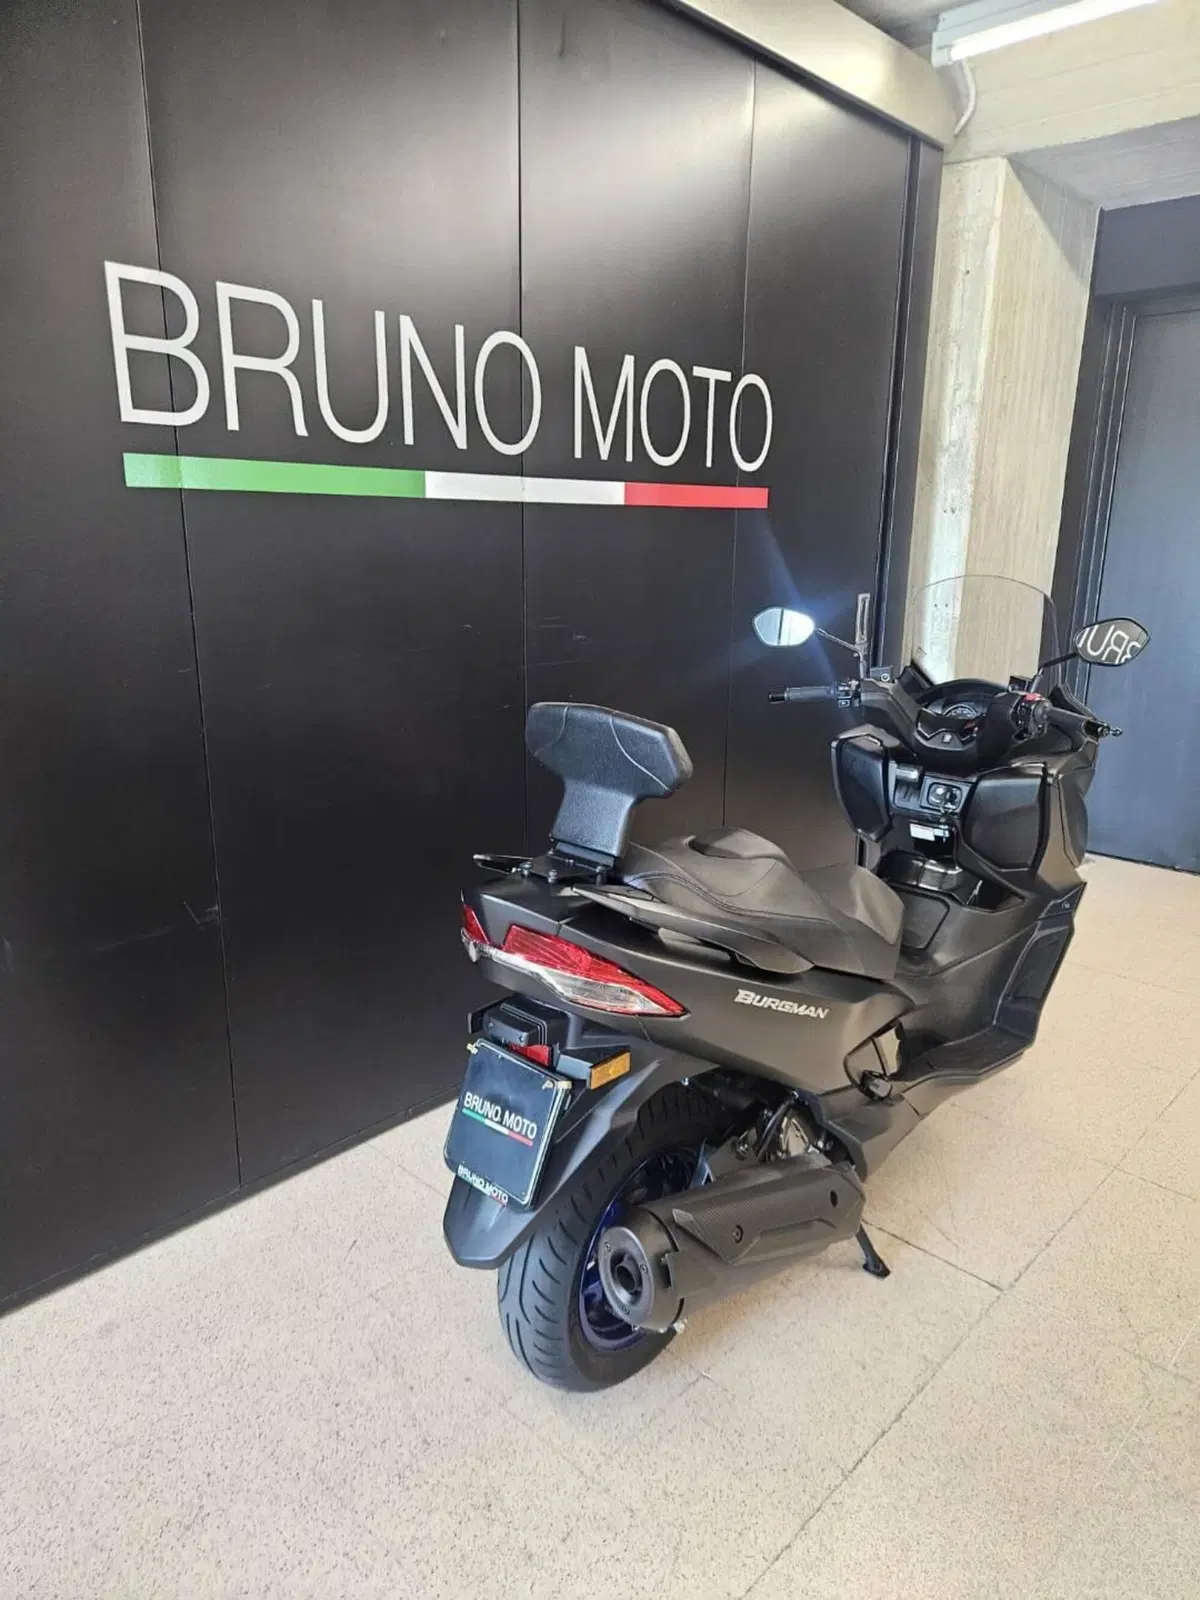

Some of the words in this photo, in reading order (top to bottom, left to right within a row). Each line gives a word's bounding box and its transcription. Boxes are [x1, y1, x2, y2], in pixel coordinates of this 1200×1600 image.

[104, 260, 541, 456] BRUNO
[573, 346, 773, 472] MOTO
[734, 989, 830, 1018] BURGMAN
[463, 1092, 501, 1121] BRUNO
[503, 1111, 537, 1139] MOTO
[457, 1164, 484, 1188] BRUNO
[485, 1182, 508, 1203] MOTO
